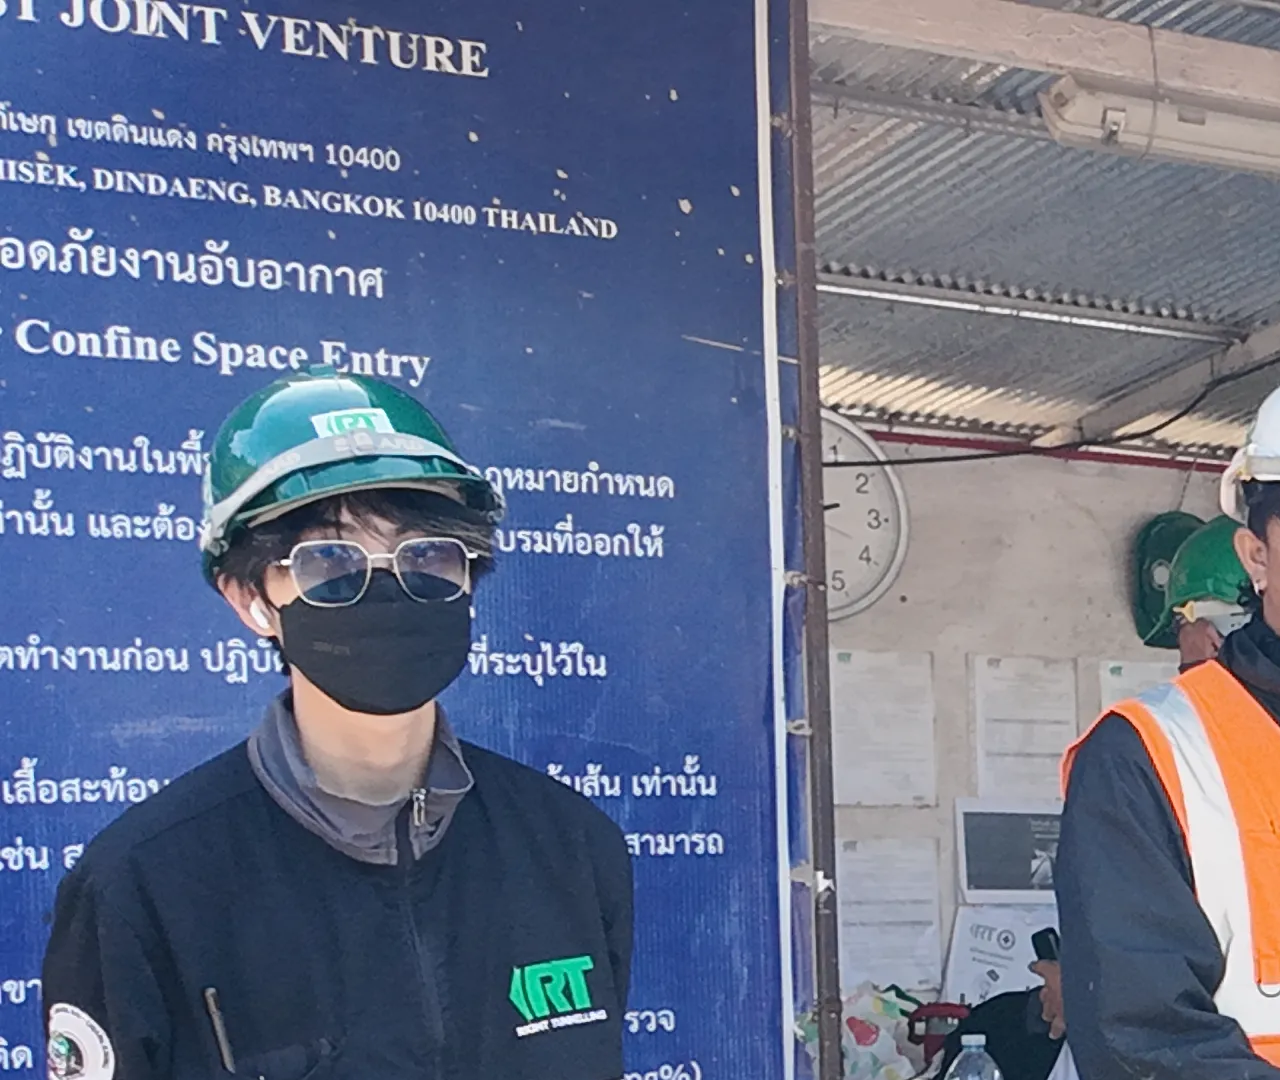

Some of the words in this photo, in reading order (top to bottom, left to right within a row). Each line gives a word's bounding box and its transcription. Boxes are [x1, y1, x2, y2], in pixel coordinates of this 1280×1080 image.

[60, 0, 228, 44] JOINT
[240, 11, 489, 77] VENTURE
[326, 144, 401, 172] 10400
[93, 168, 257, 208] DINDAENG,
[263, 185, 405, 220] BANGKOK
[412, 201, 477, 225] 10400
[482, 207, 619, 240] THAILAND
[15, 319, 182, 363] Confine
[193, 331, 309, 376] Space
[320, 341, 431, 387] Entry
[855, 472, 870, 494] 2
[867, 508, 882, 530] 3
[858, 545, 872, 565] 4
[831, 569, 846, 592] 5
[632, 755, 717, 797] เท่านั้น
